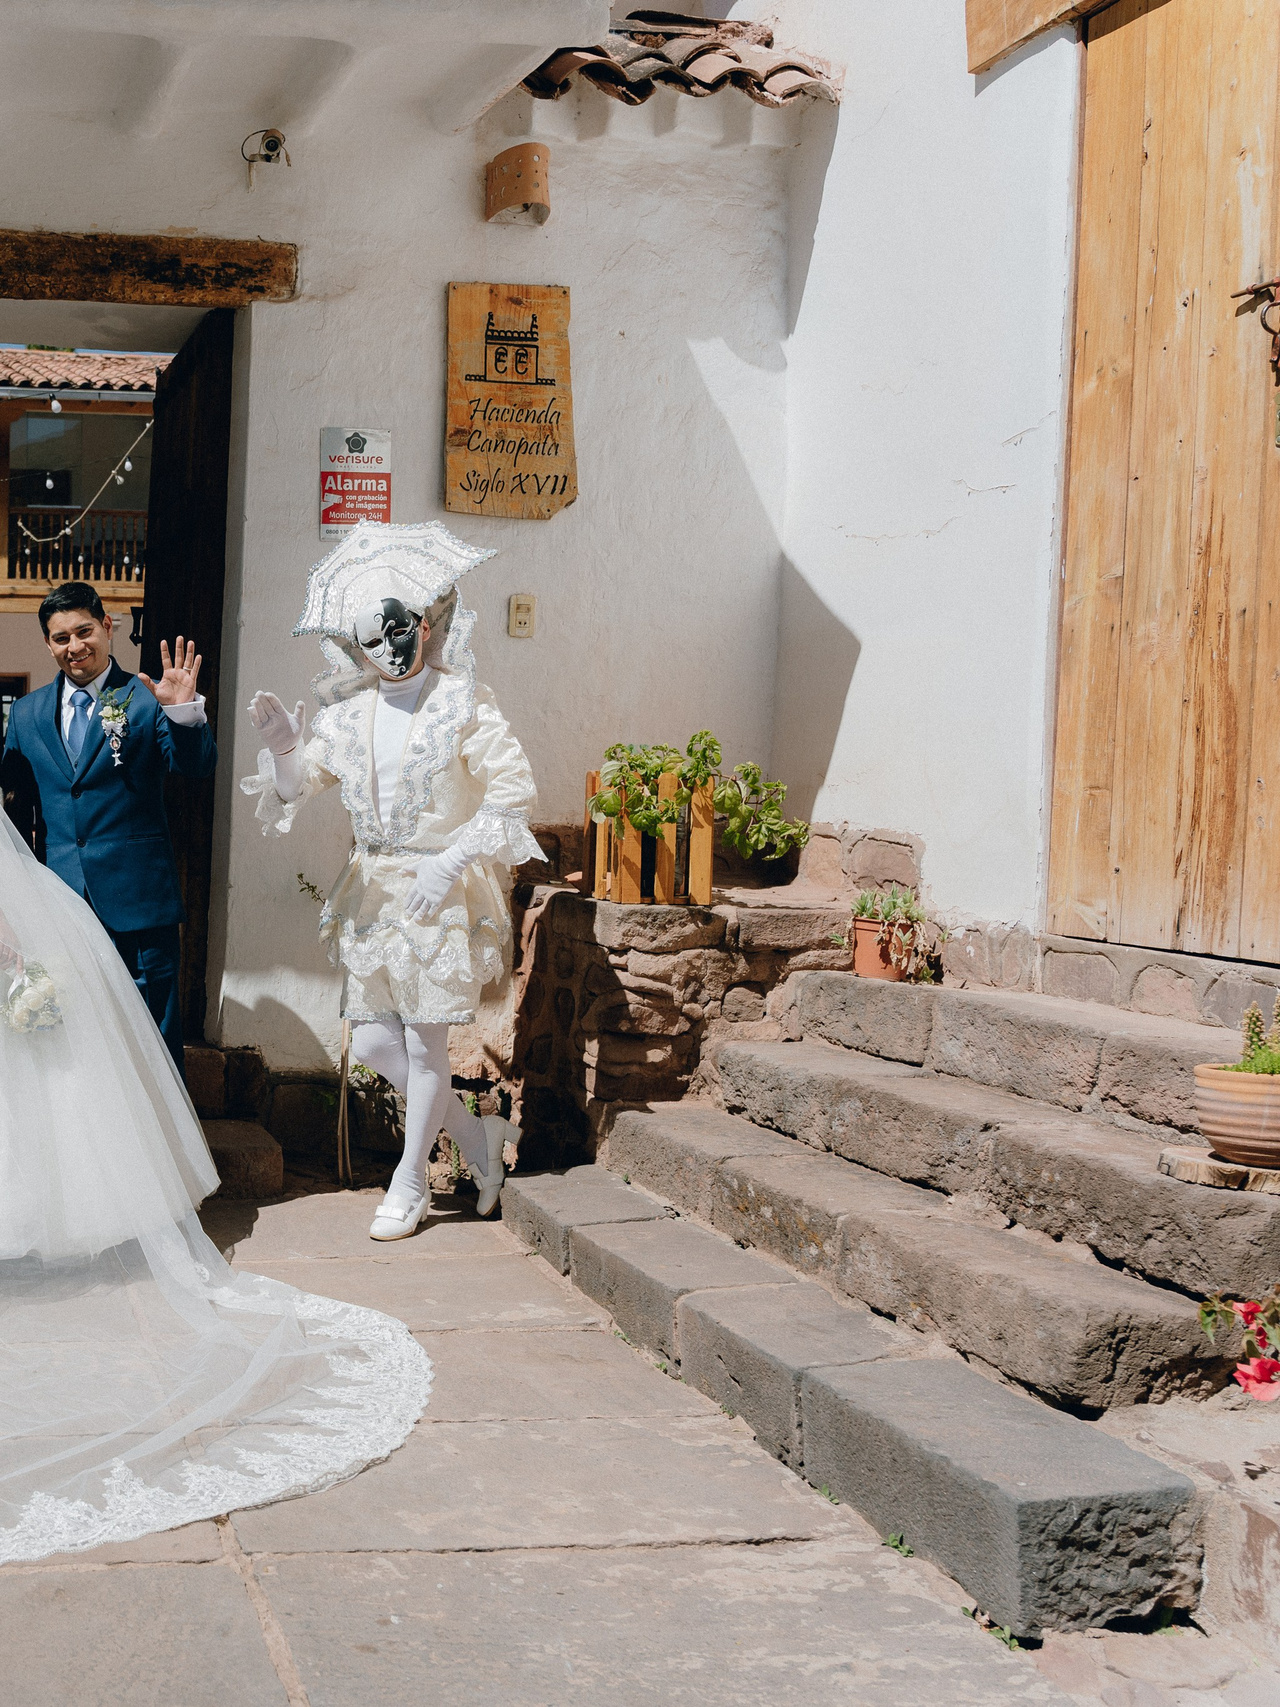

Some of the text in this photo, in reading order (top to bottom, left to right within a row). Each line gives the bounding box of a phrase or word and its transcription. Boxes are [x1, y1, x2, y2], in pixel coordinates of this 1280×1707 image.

[469, 398, 561, 424] Hacienda
[466, 429, 560, 467] Canopata
[328, 454, 384, 465] verisure
[324, 474, 388, 491] Alarma
[459, 468, 568, 504] Siglo XVII
[357, 493, 388, 502] grabación
[345, 501, 388, 510] de imágenes
[329, 511, 383, 520] Monitoreo 24H
